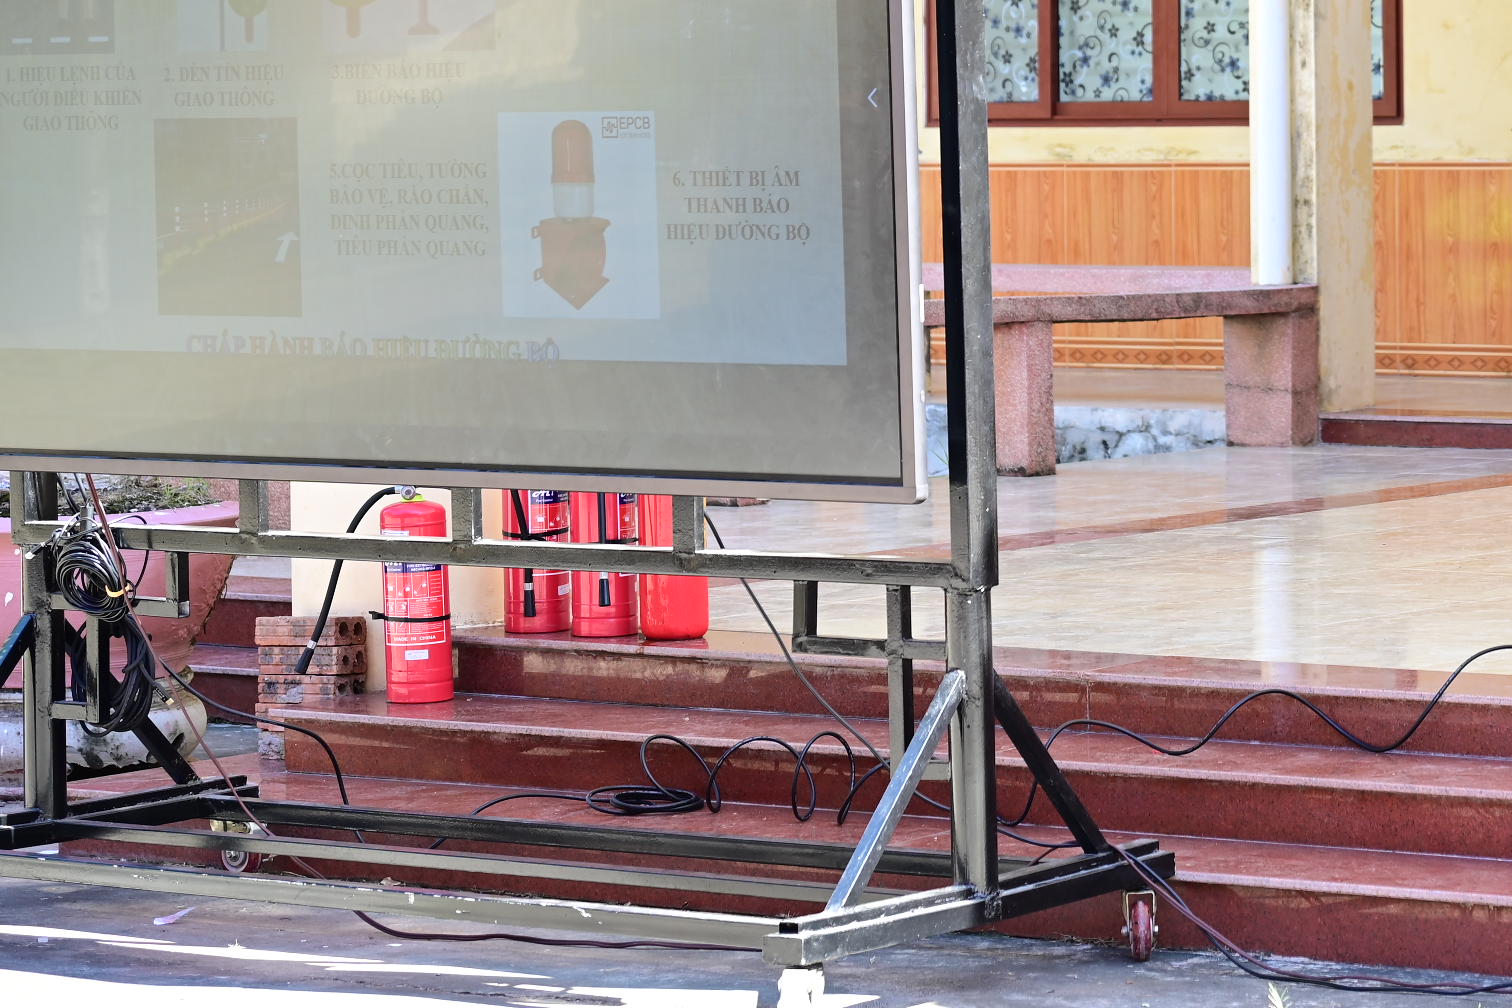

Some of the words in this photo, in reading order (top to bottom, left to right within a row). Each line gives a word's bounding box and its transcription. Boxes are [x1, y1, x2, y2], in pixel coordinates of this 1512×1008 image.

[619, 116, 651, 130] EPCB
[672, 171, 686, 187] 6.
[748, 171, 768, 192] BỊ
[683, 197, 747, 214] THANH
[751, 192, 790, 214] BÁO
[665, 222, 710, 245] HIỆU
[785, 222, 811, 246] BỘ
